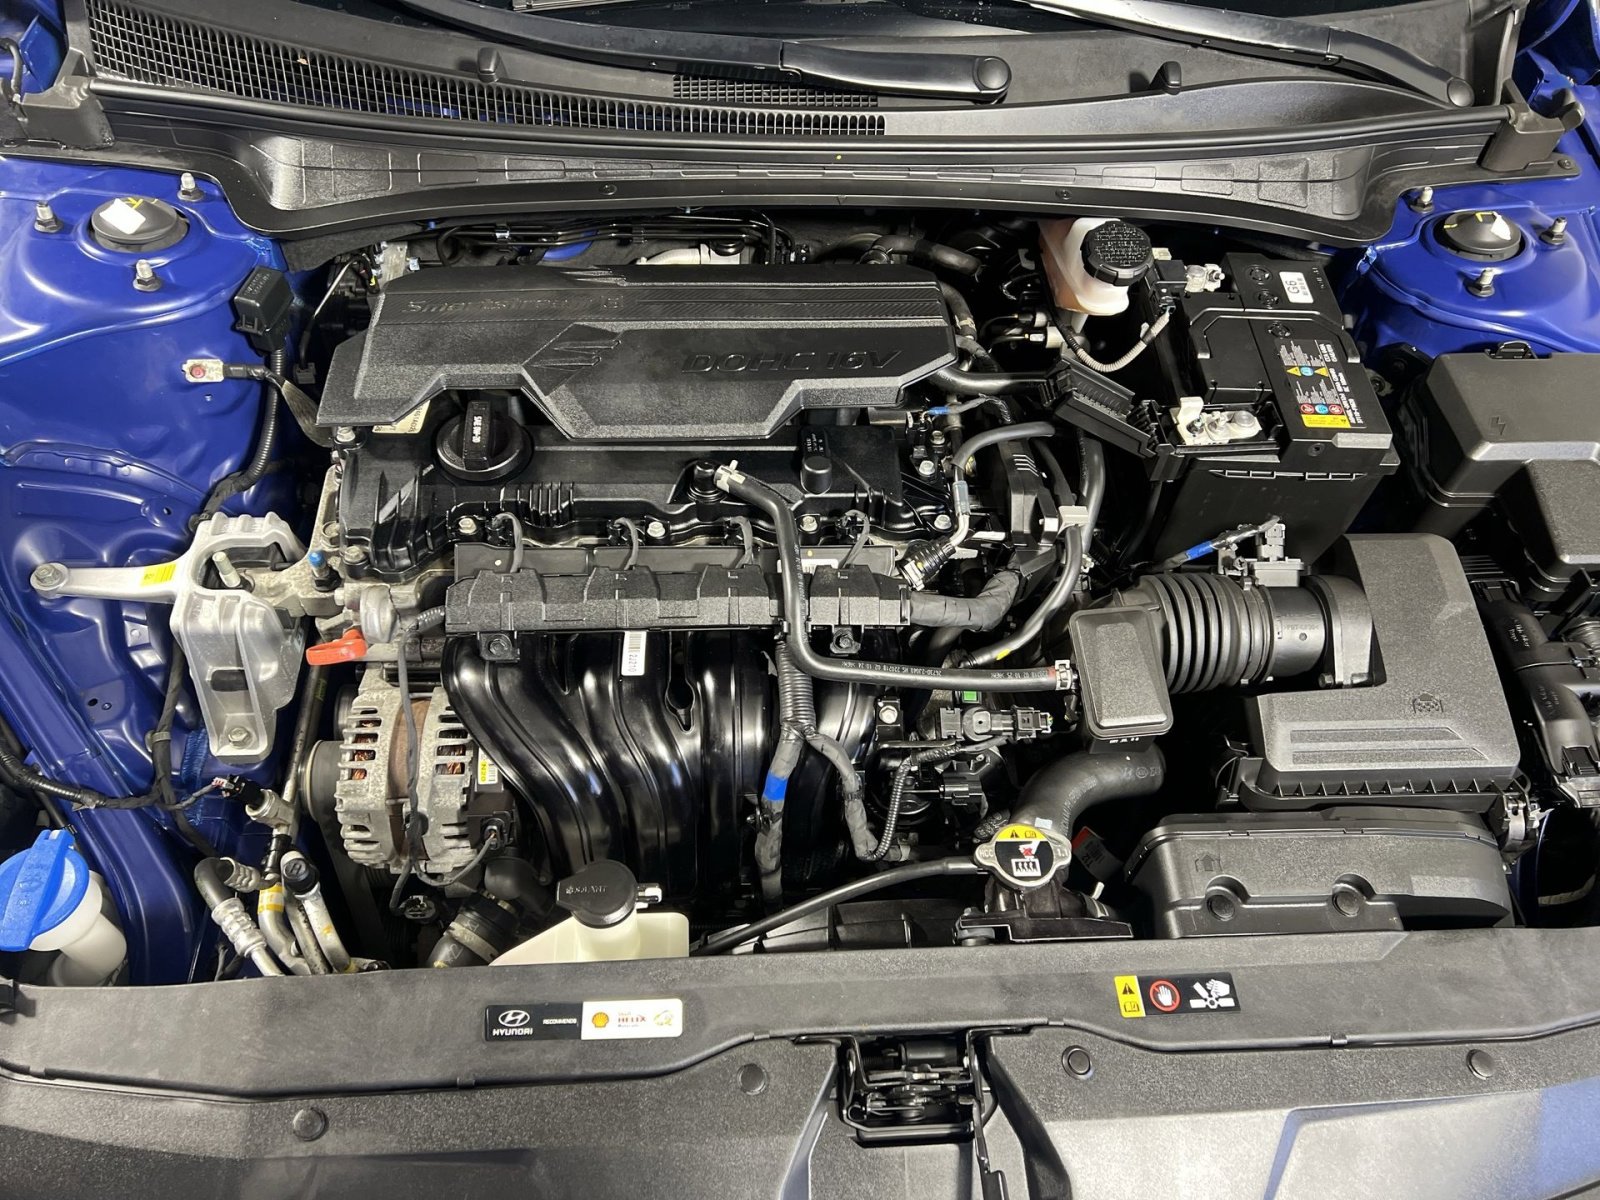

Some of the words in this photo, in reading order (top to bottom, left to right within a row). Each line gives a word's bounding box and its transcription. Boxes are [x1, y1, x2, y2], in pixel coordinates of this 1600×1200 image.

[682, 352, 815, 372] DOHC
[826, 350, 901, 370] 16V
[492, 1027, 533, 1036] HYUNDAI
[542, 1017, 578, 1025] RECOMMENDS
